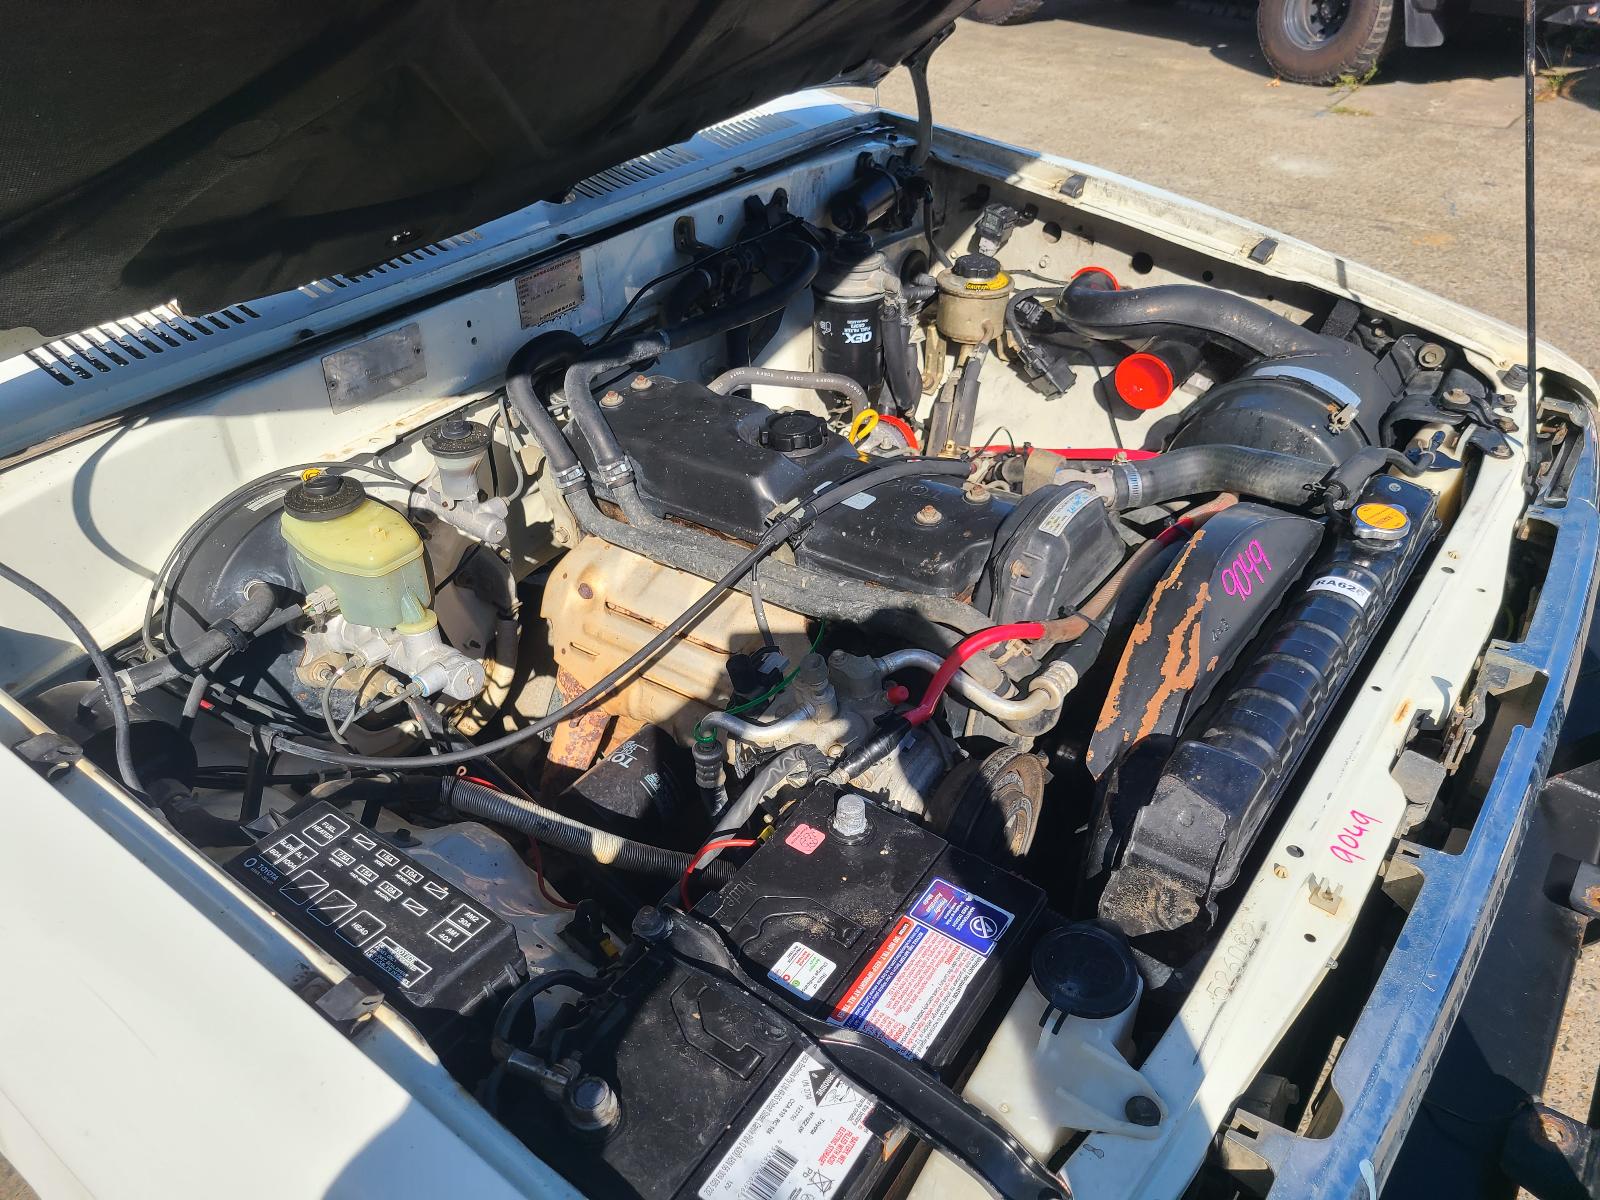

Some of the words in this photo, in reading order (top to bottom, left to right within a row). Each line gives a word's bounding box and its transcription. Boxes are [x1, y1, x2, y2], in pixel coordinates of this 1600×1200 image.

[1221, 538, 1272, 602] 9049
[1315, 577, 1369, 597] RA62
[608, 753, 634, 768] TO
[312, 824, 333, 841] HEATER
[322, 821, 337, 833] FUEL
[1330, 810, 1383, 864] 9049
[294, 850, 307, 861] ALT
[381, 853, 393, 863] 15A
[257, 864, 279, 882] TOYOTA
[405, 869, 417, 880] 10A
[457, 917, 472, 929] 30A
[464, 910, 479, 923] AM2
[351, 922, 368, 936] HEAD
[445, 927, 459, 939] AM1
[438, 932, 452, 944] 40A
[394, 946, 417, 964] NOTICE
[815, 1072, 834, 1096] ORROSIVE
[809, 1118, 825, 1136] Toyota
[802, 1167, 813, 1179] Pb
